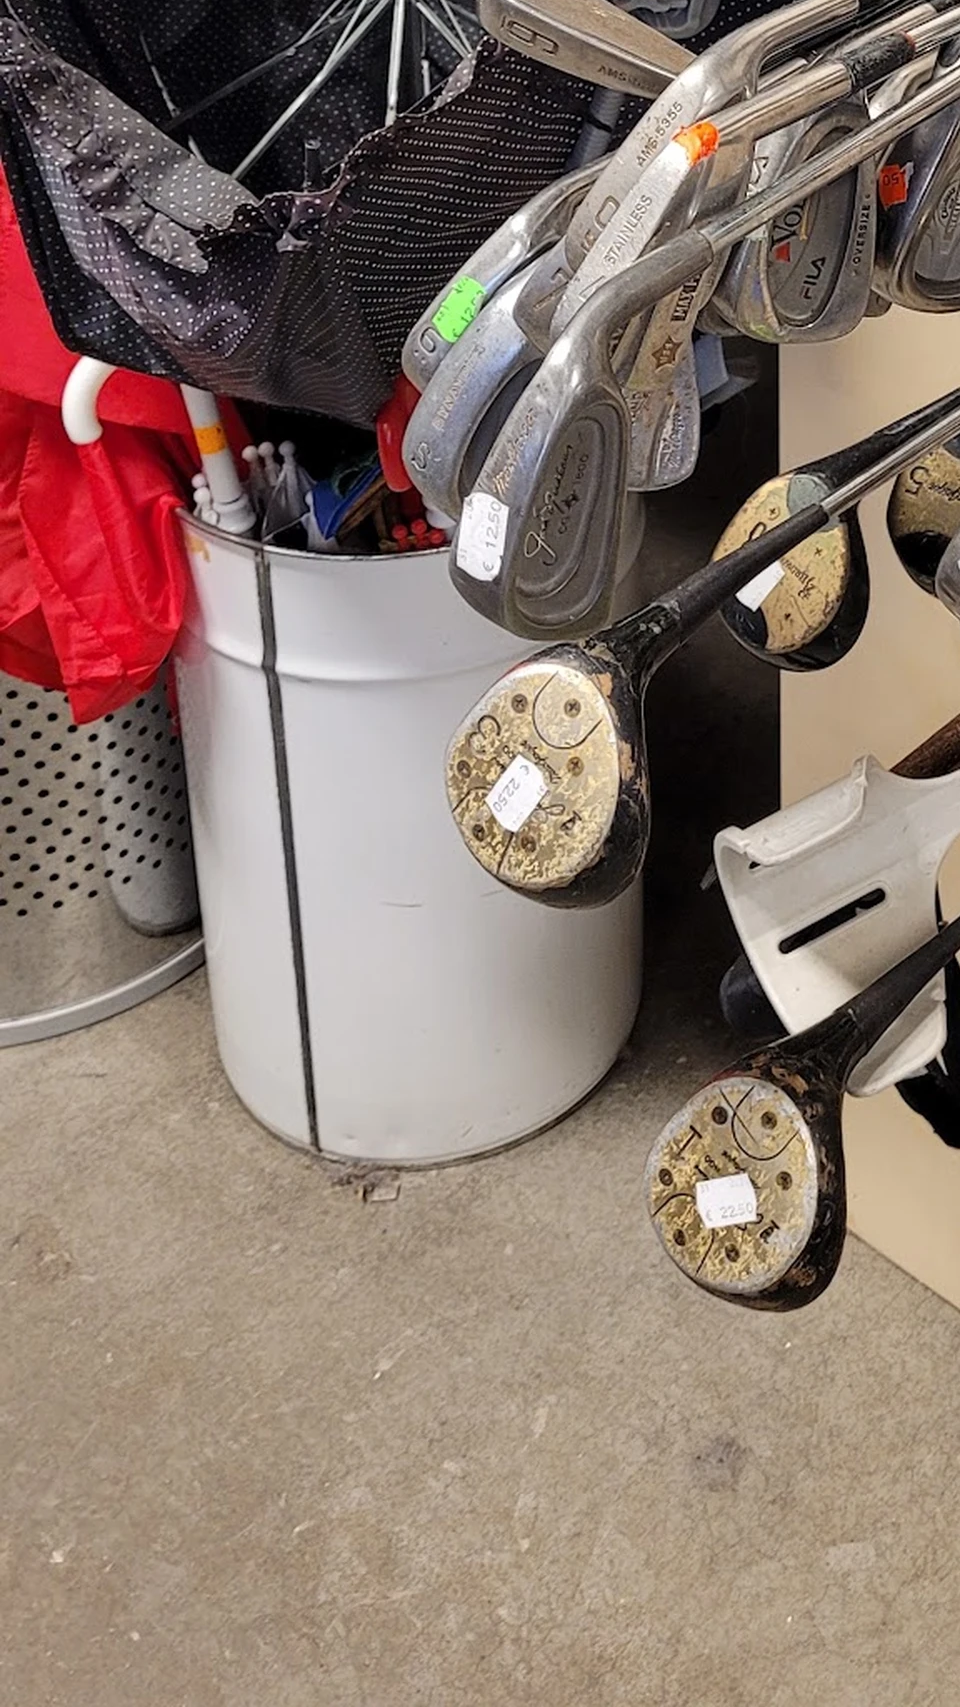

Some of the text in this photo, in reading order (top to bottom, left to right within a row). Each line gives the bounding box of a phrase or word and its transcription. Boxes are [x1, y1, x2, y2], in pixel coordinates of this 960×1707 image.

[602, 194, 654, 267] STAINLESS
[851, 203, 872, 266] OVERSIZE
[802, 255, 828, 300] FILA
[905, 465, 930, 496] 5
